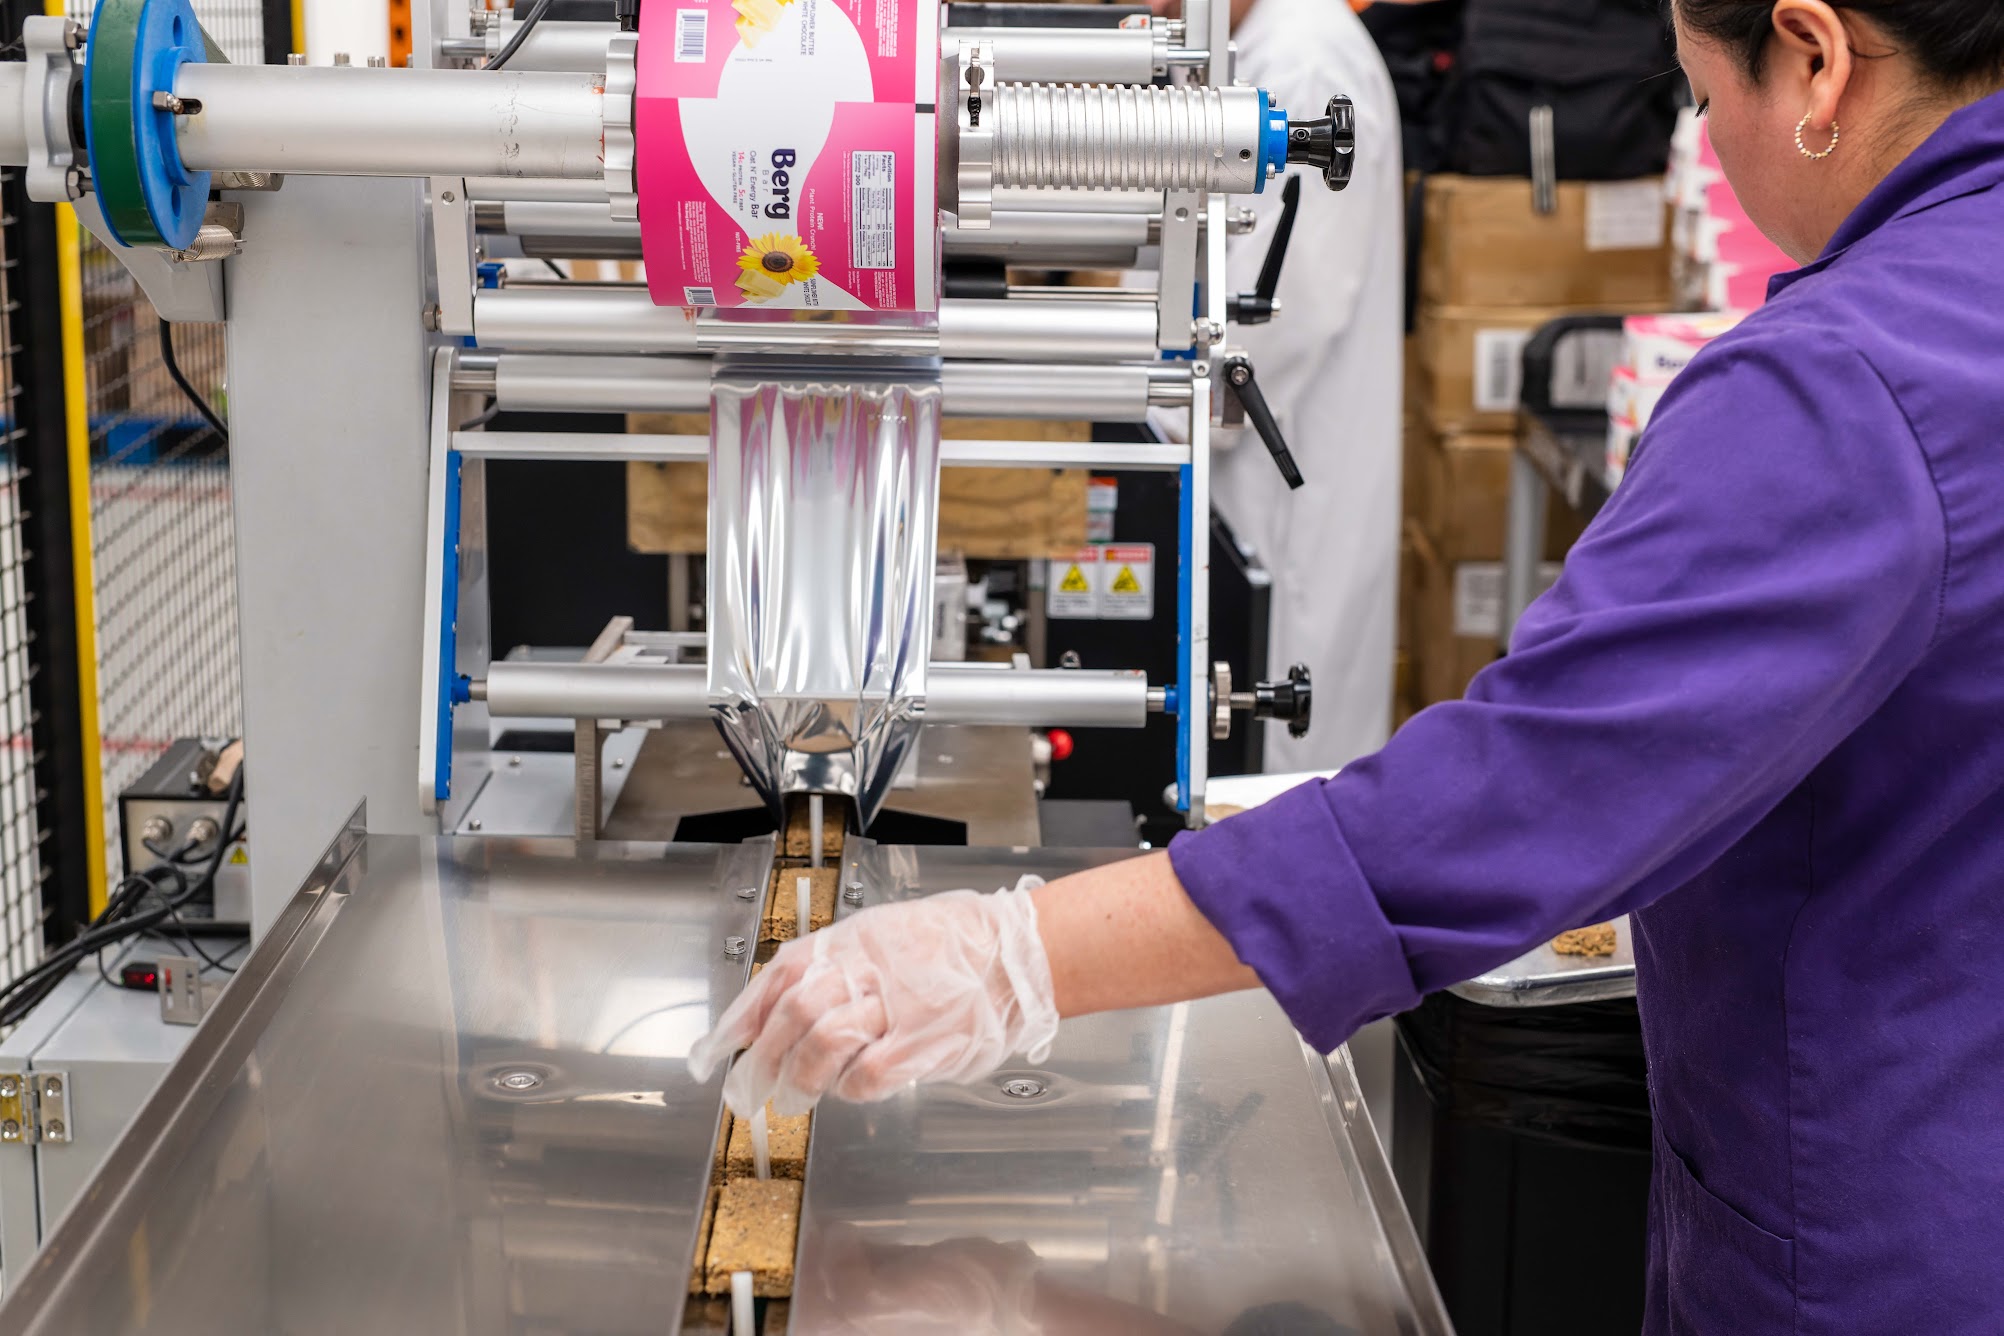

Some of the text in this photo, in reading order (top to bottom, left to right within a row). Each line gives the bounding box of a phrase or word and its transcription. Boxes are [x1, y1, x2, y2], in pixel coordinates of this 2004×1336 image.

[749, 176, 757, 202] Energy
[762, 170, 770, 192] Bar
[765, 149, 796, 219] Berg
[751, 204, 760, 219] Bar
